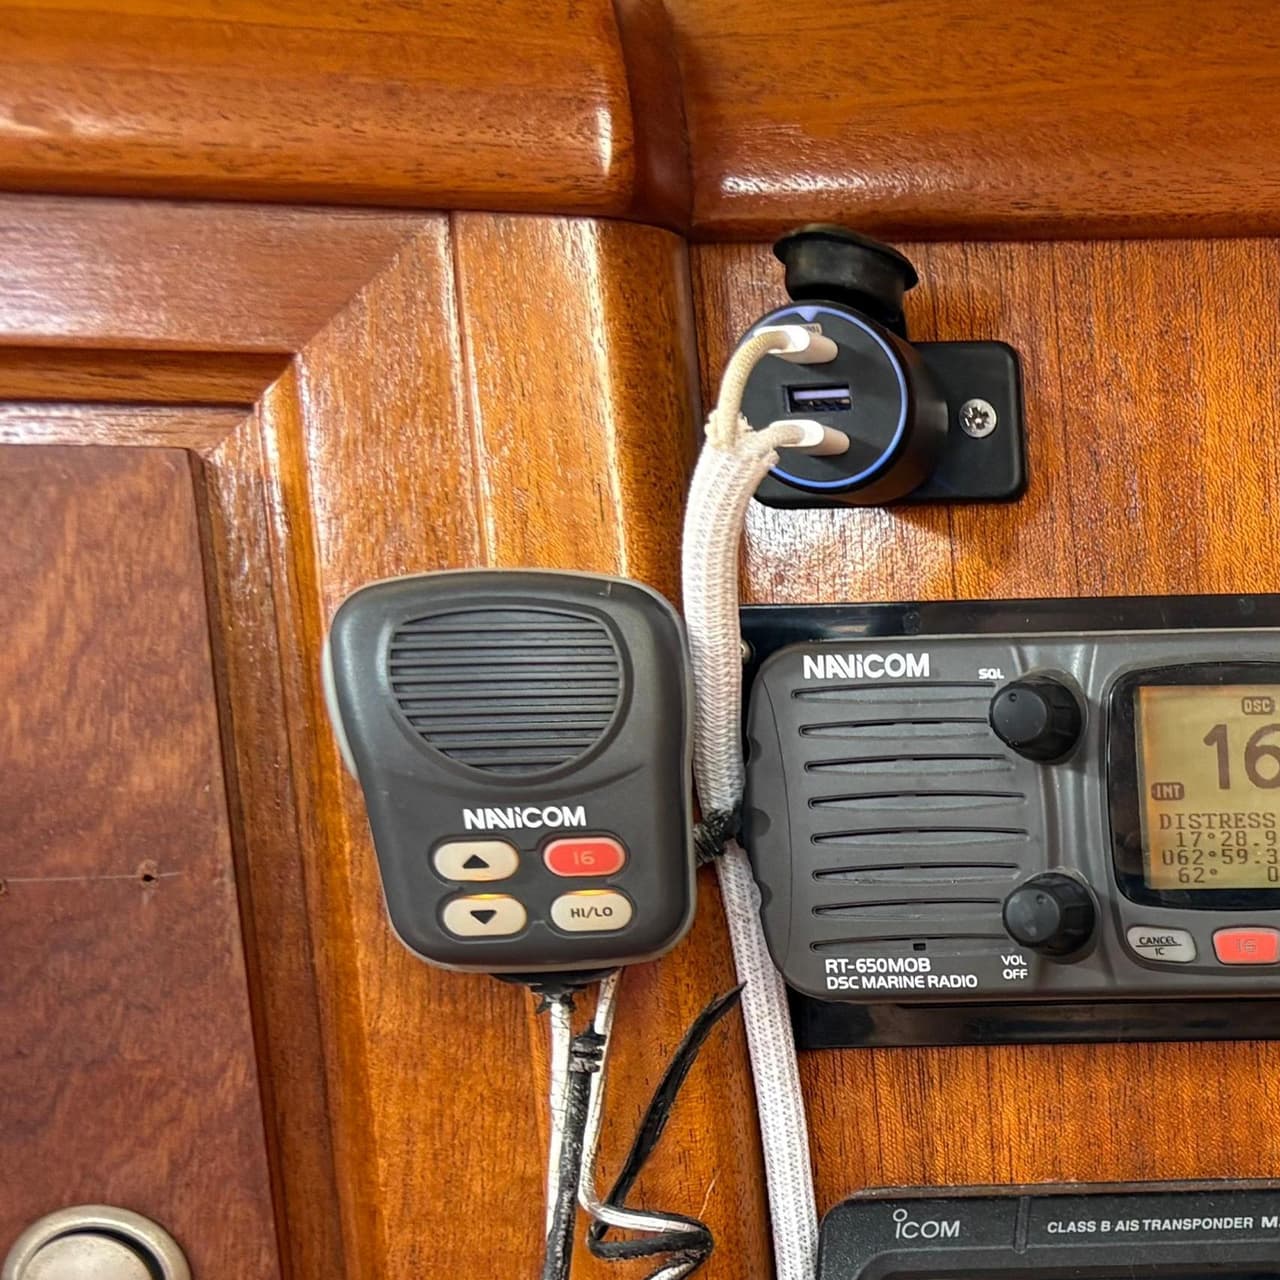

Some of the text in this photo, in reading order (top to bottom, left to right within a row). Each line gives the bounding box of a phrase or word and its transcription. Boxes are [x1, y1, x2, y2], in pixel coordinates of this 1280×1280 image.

[978, 668, 1004, 679] SQL
[1160, 812, 1276, 830] DISTRESS
[571, 905, 612, 919] HI/LO
[1139, 936, 1177, 945] CANCEL
[825, 958, 931, 975] RT-650MOB
[1001, 955, 1026, 967] VOL
[1002, 968, 1028, 980] OFF
[826, 974, 978, 990] DSC MARINE RADIO
[1047, 1221, 1096, 1233] CLASS
[1101, 1220, 1111, 1231] B
[1116, 1220, 1139, 1231] AIS
[1143, 1217, 1253, 1231] TRANSPONDER
